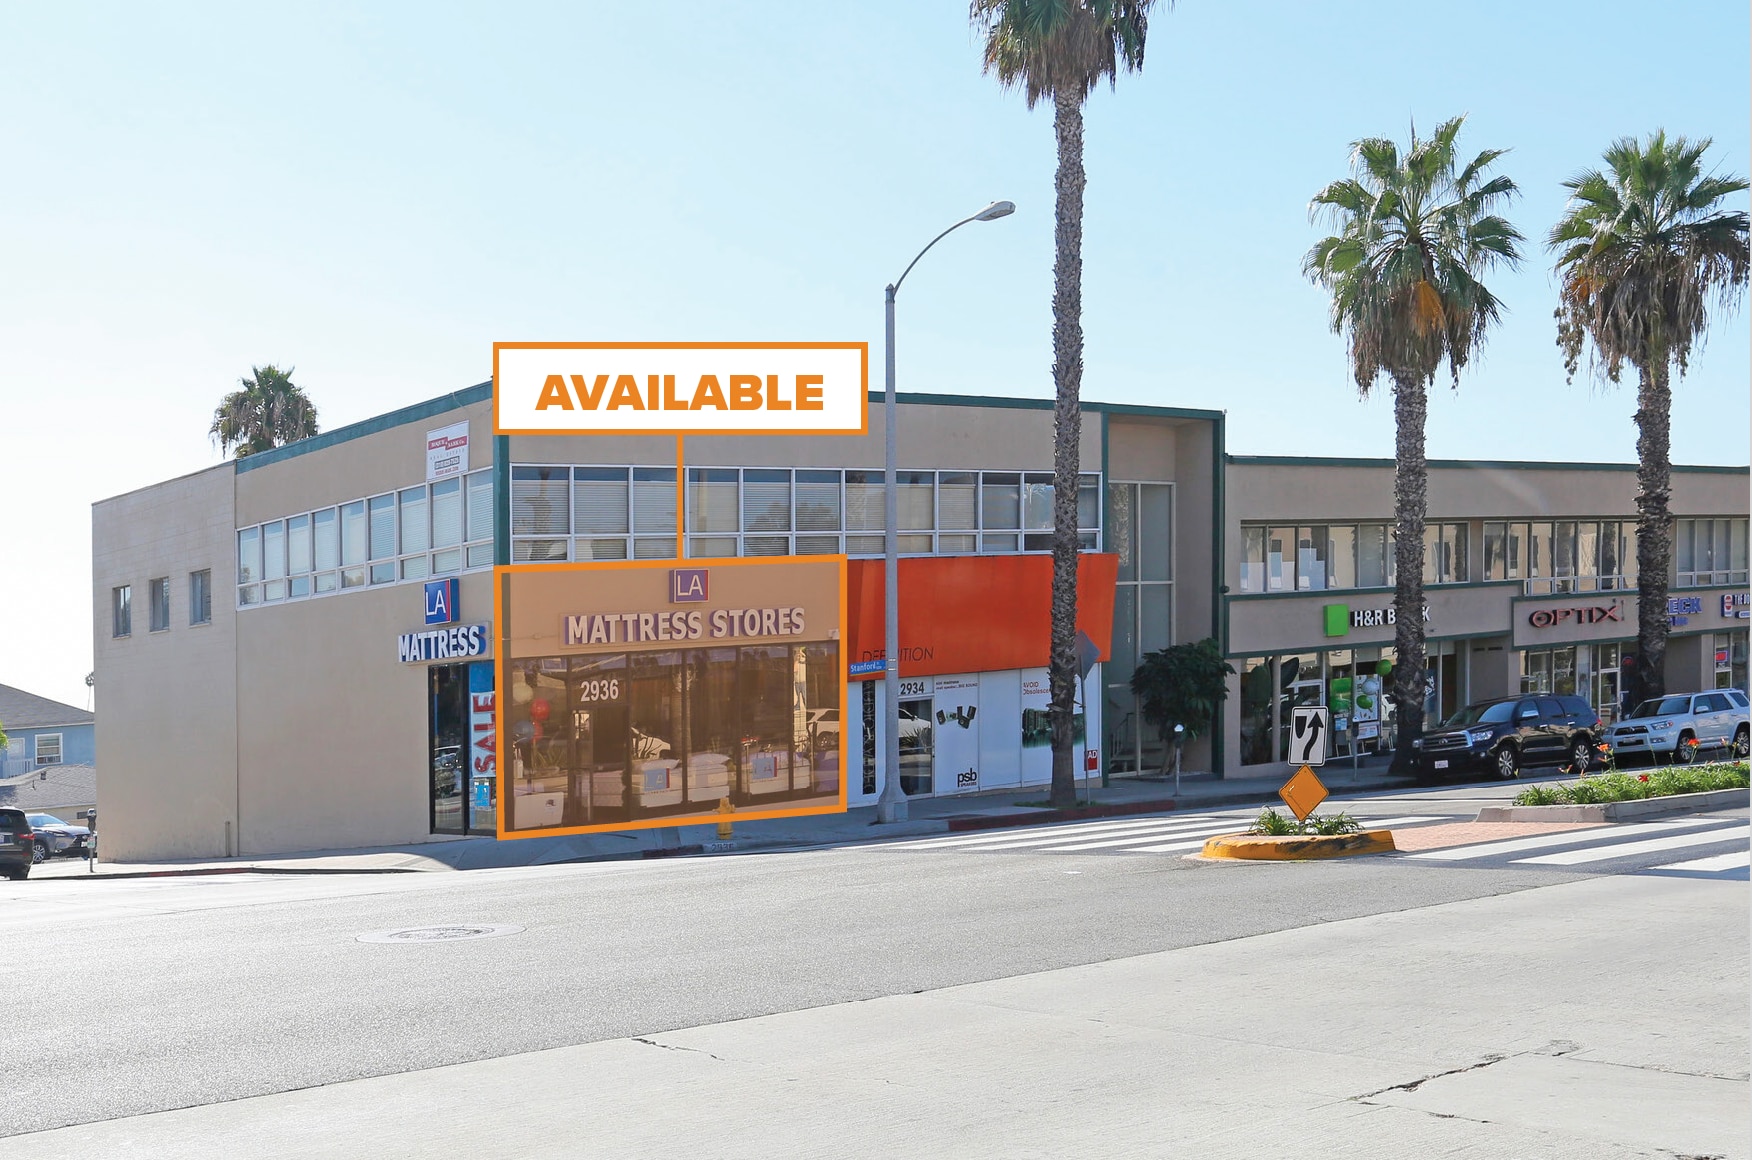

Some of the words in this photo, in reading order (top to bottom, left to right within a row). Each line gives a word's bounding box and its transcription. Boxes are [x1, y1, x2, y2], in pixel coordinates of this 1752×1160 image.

[677, 575, 703, 596] LA
[425, 589, 446, 616] LA
[567, 611, 703, 644] MATTRESS
[712, 608, 805, 638] STORES
[1354, 609, 1383, 627] H&R
[1532, 605, 1620, 628] OPTIX
[398, 626, 480, 662] MATTRESS
[862, 647, 934, 662] DEFITION
[850, 661, 876, 673] Stanford
[580, 679, 619, 702] 2936
[900, 681, 924, 695] 2934
[472, 694, 497, 773] SALE
[957, 767, 978, 788] psb
